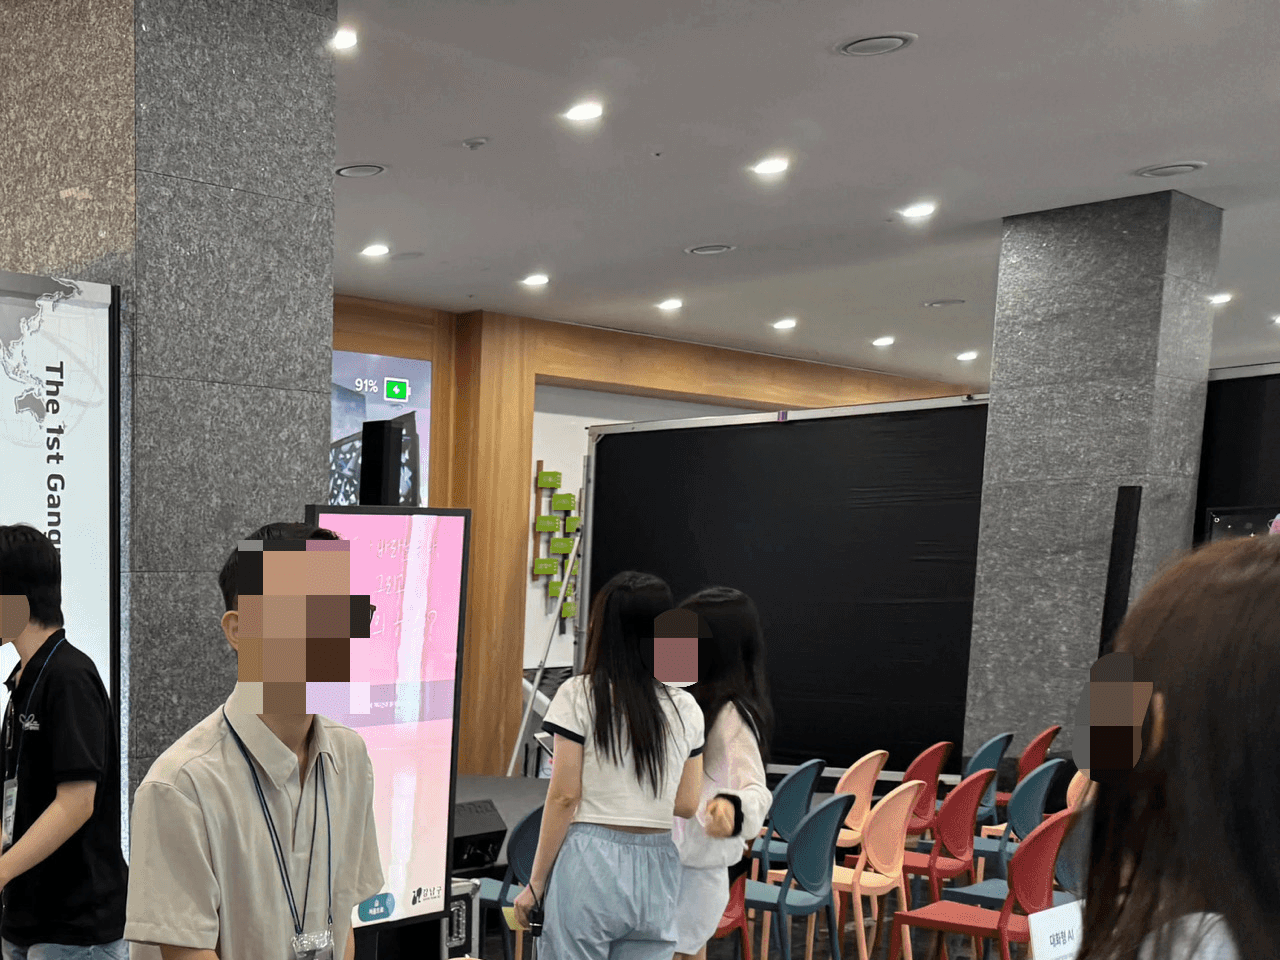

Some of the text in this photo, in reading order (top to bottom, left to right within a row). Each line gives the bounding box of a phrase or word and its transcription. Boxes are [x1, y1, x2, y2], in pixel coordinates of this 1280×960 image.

[355, 378, 378, 393] 91%
[44, 361, 65, 550] The 1st Gang
